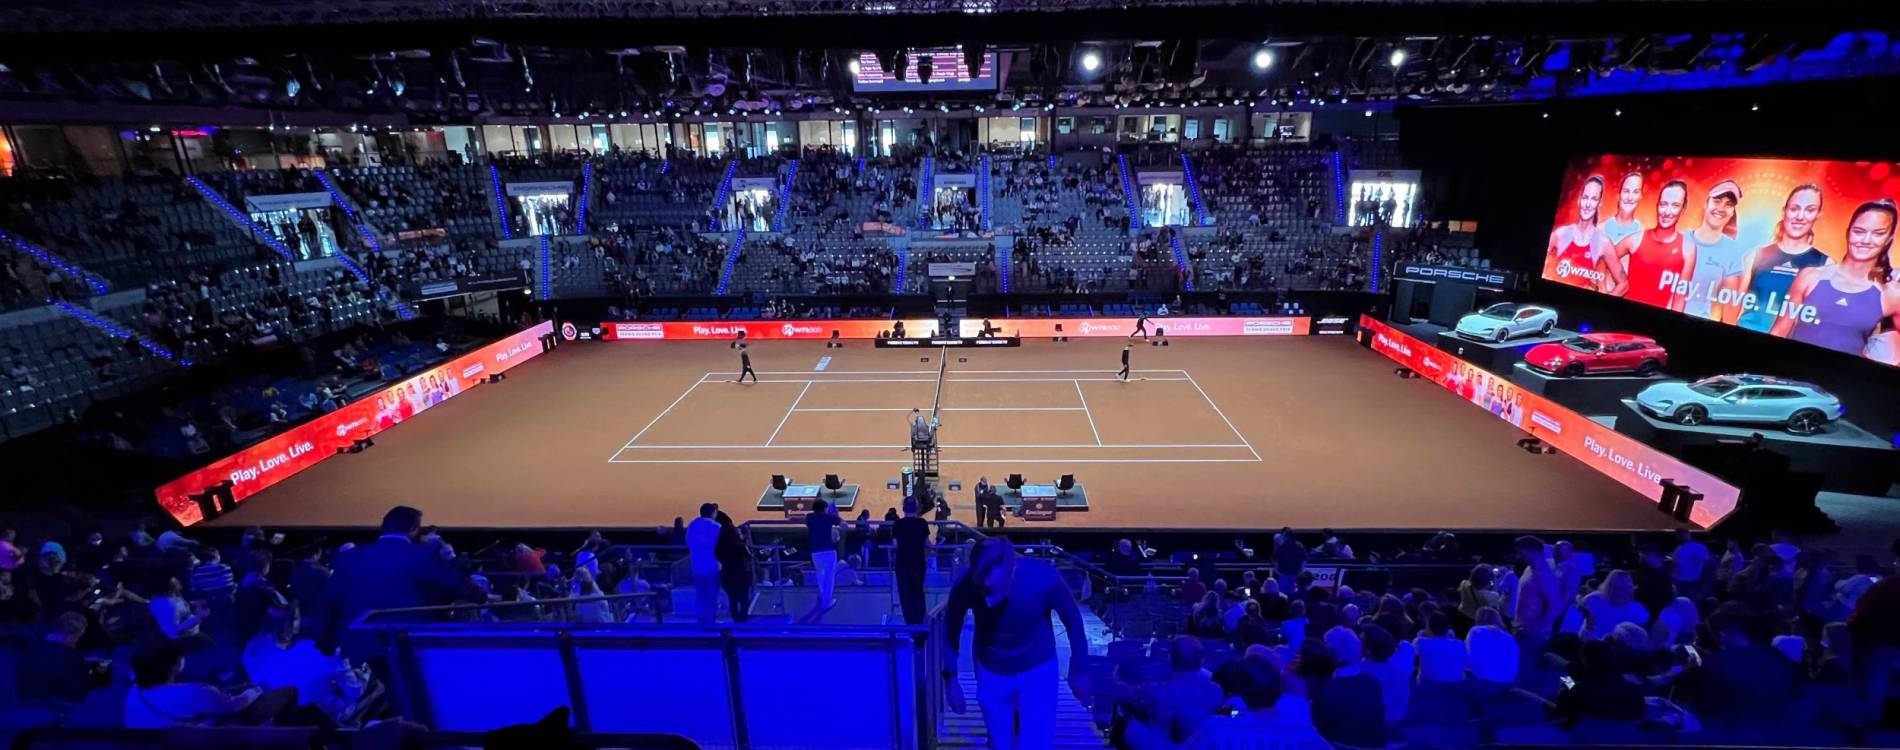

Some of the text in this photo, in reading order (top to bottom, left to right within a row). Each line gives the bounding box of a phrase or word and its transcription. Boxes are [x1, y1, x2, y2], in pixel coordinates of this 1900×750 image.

[1405, 266, 1504, 284] PORSCHE
[1570, 266, 1605, 281] WTA500
[1658, 270, 1821, 325] Play. Love. Live.
[230, 441, 314, 485] Play. Love. Live.
[1584, 436, 1607, 457] Play.
[1608, 448, 1635, 472] Love.
